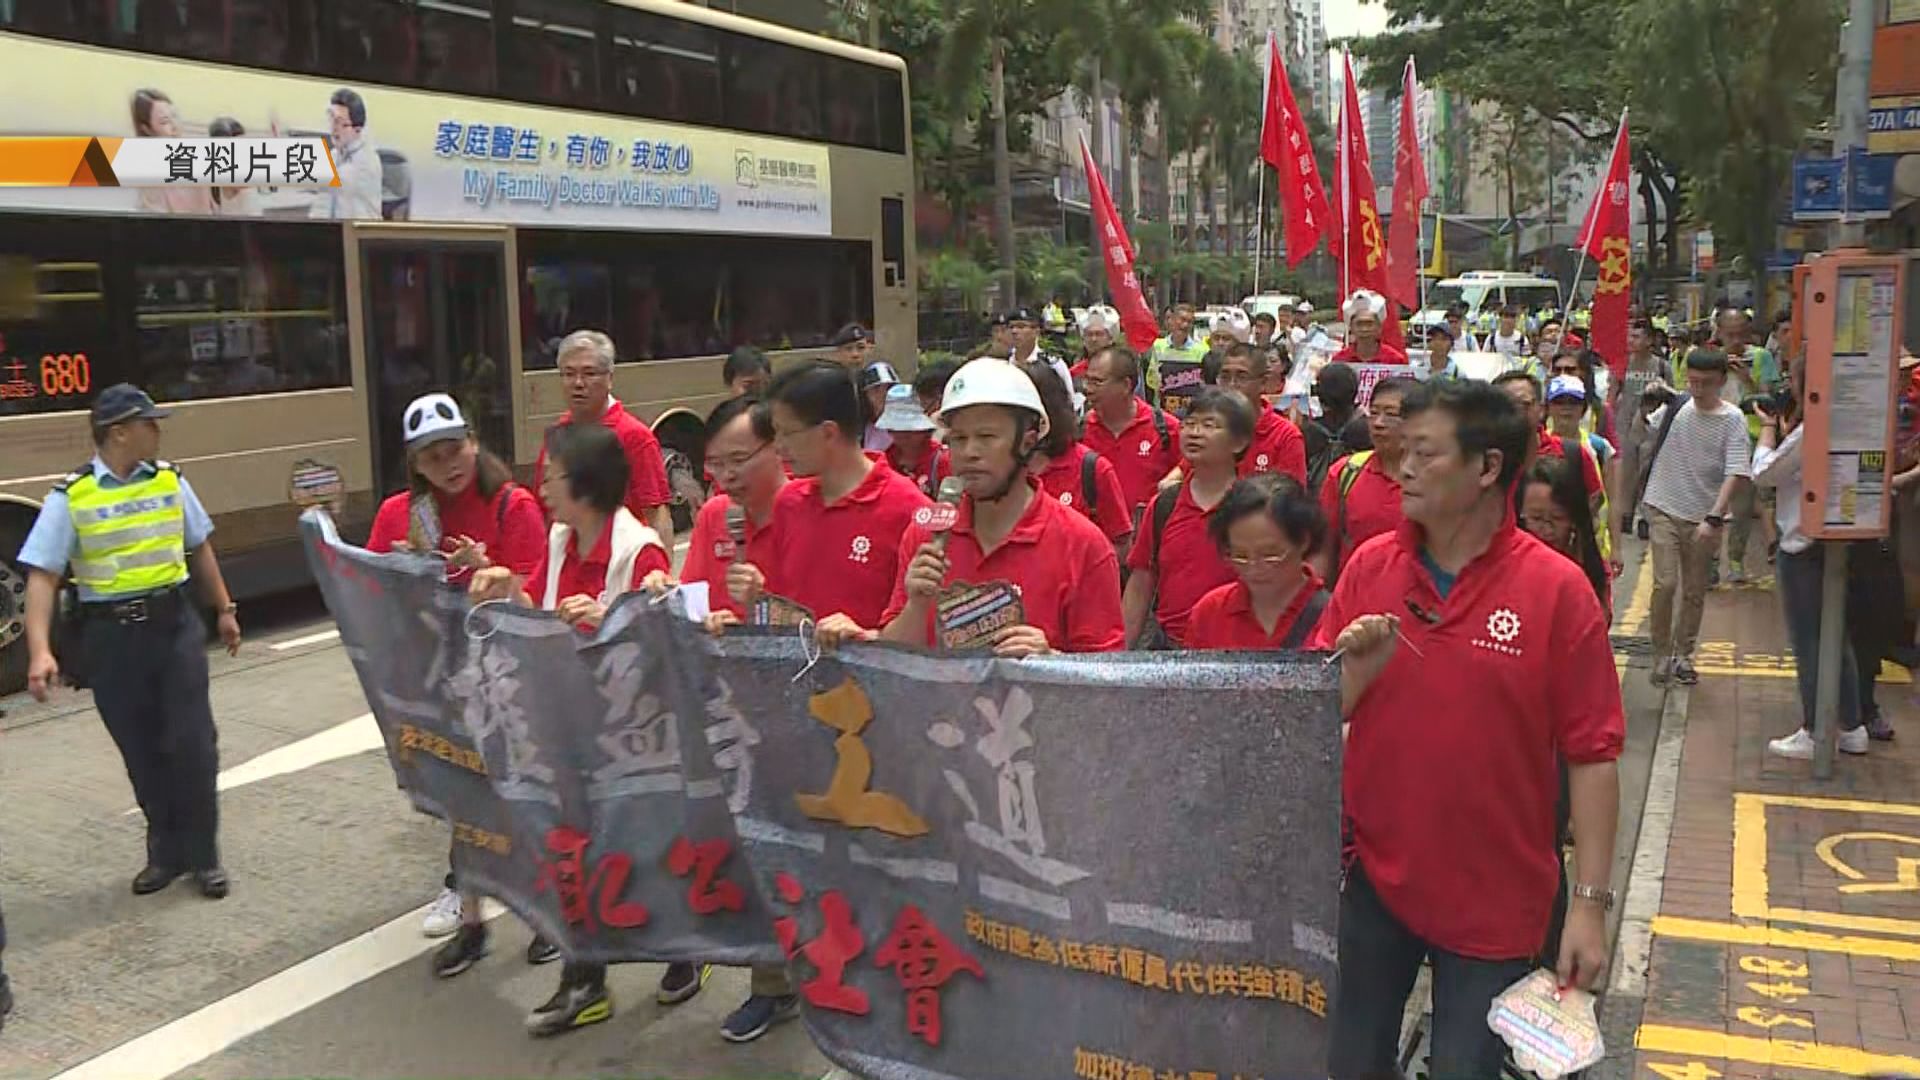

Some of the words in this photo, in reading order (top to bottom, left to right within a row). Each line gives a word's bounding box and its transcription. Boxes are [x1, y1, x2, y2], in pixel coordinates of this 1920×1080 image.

[463, 169, 488, 206] My
[495, 172, 552, 206] Family
[557, 176, 615, 203] Doctor
[616, 180, 663, 206] Walks
[667, 184, 699, 208] with
[699, 186, 722, 209] Me
[41, 353, 90, 395] 680
[113, 498, 161, 514] POLICE
